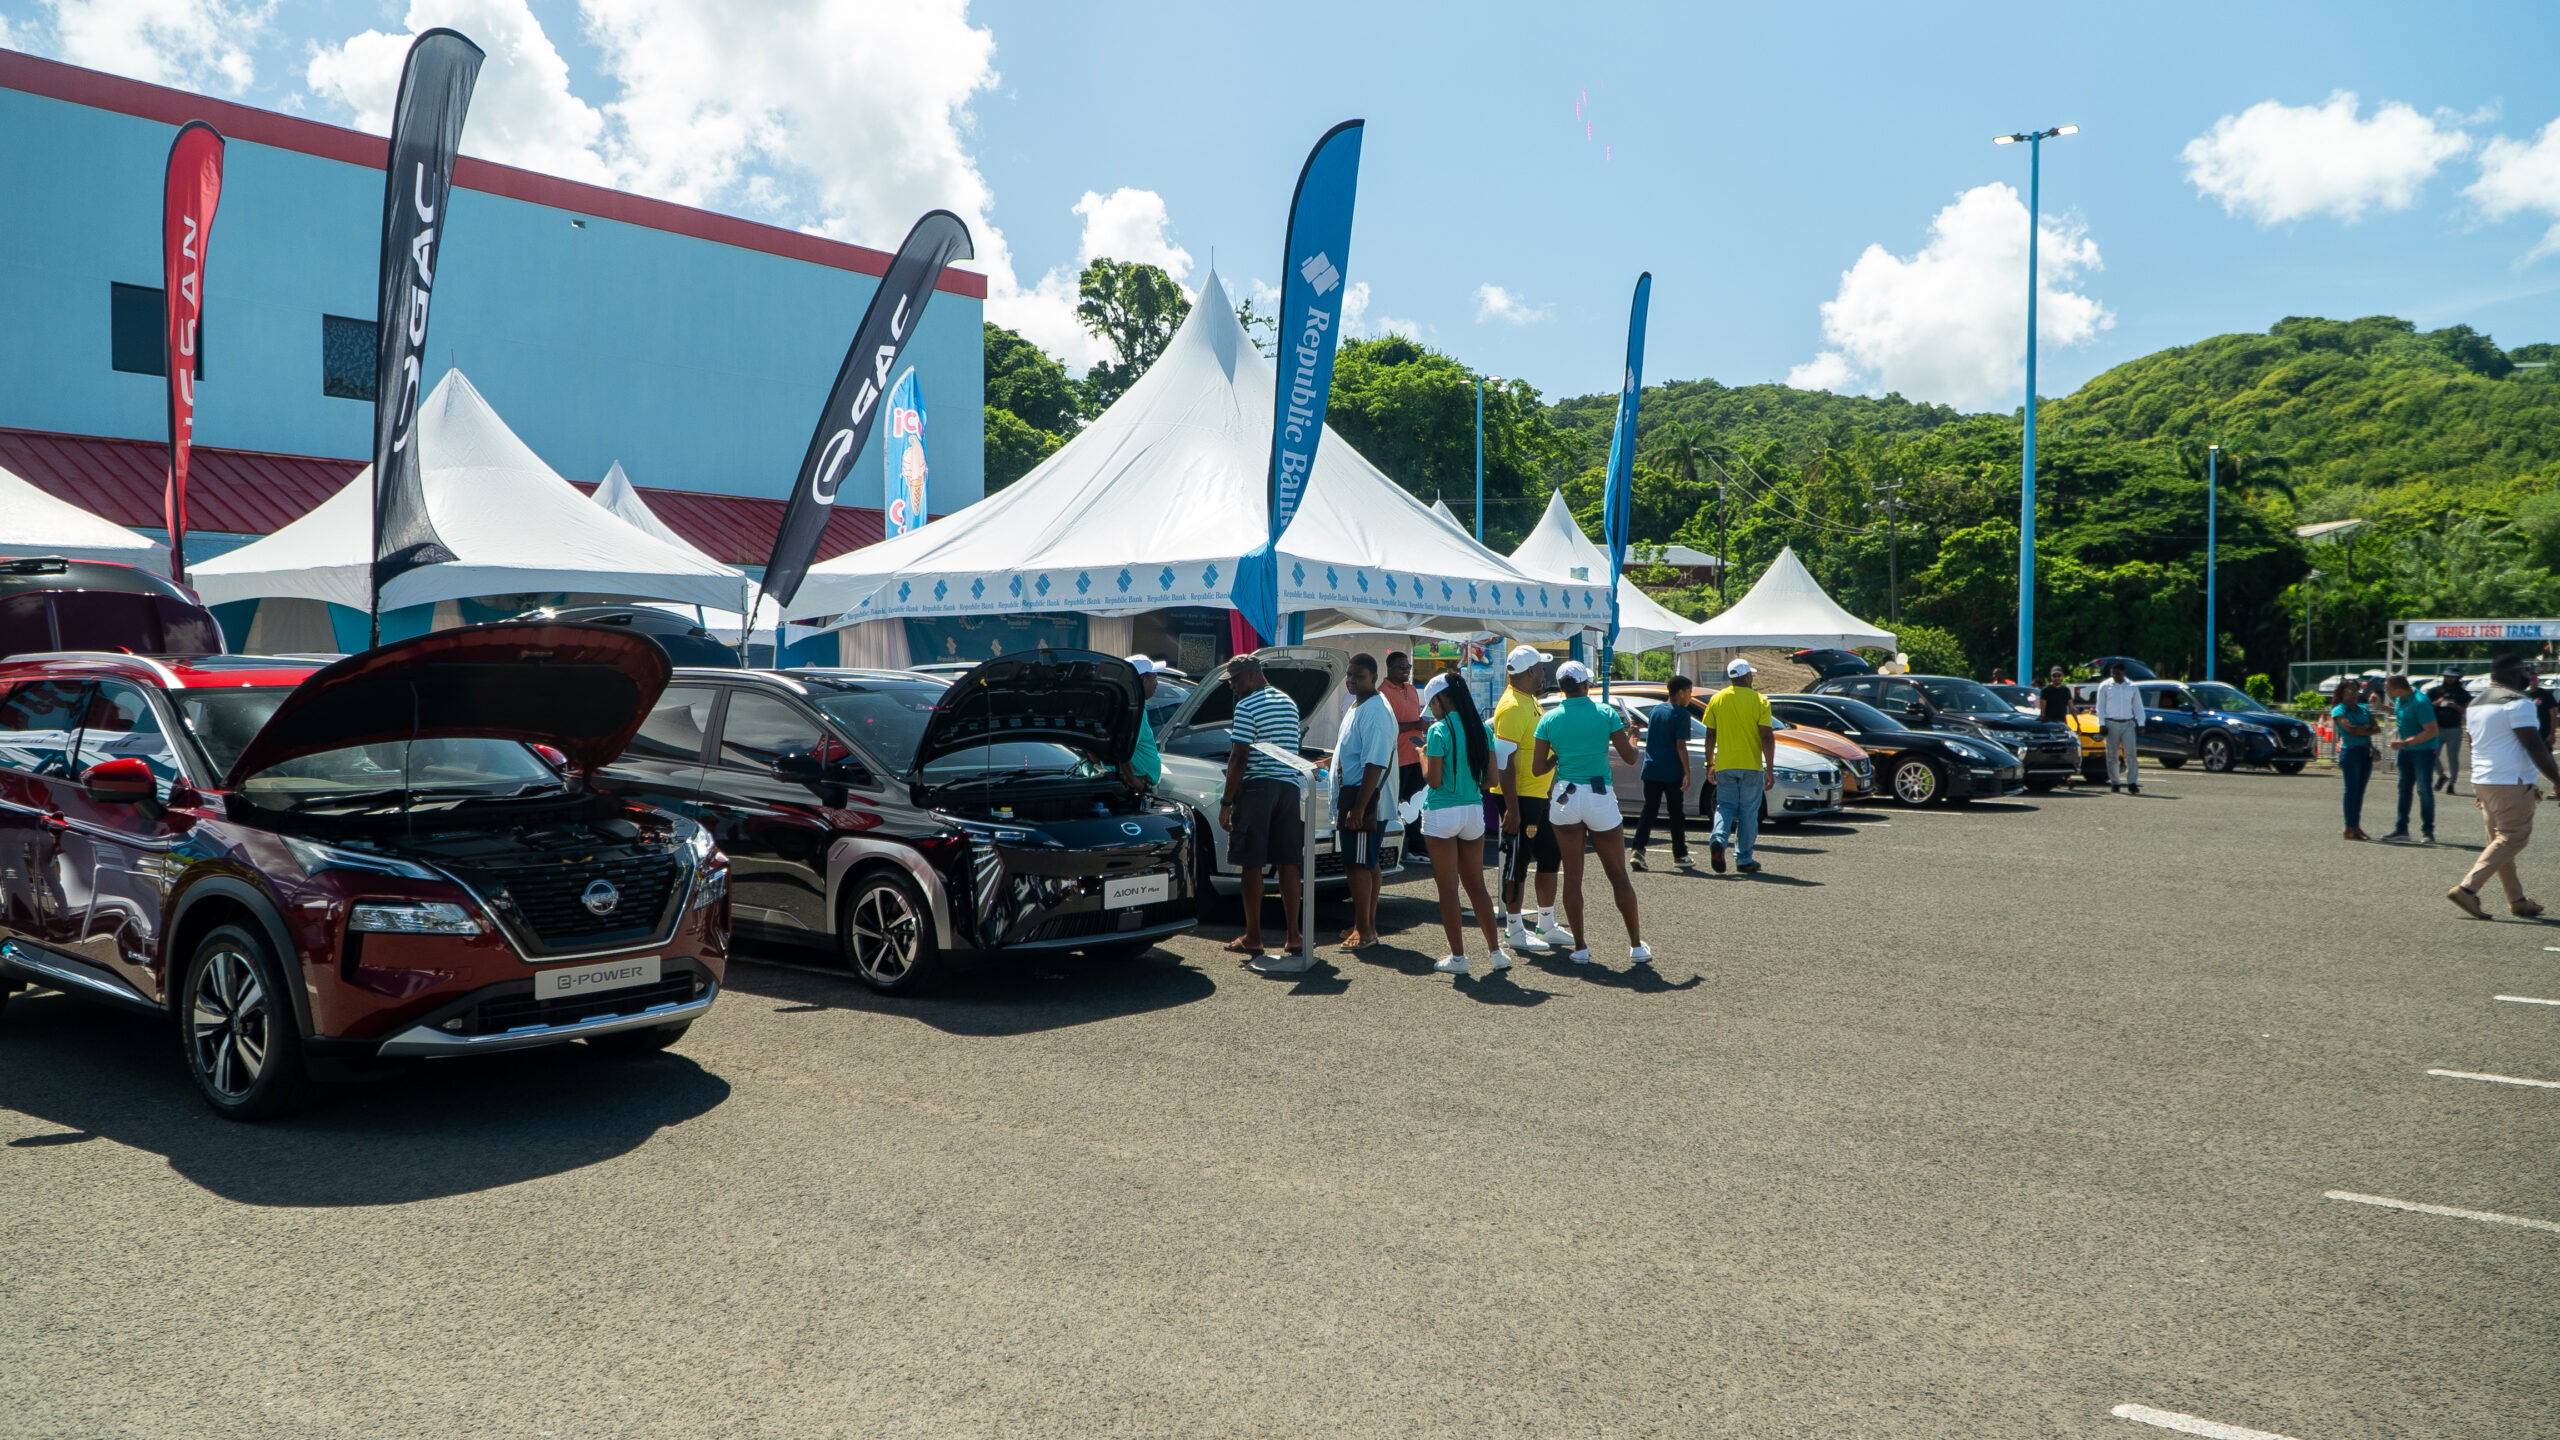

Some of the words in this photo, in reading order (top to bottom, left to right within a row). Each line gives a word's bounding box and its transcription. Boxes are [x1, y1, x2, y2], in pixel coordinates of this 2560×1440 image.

[409, 161, 436, 347] GAC
[851, 293, 911, 426] GAC
[1284, 305, 1331, 443] Republic
[1190, 592, 1214, 602] Republic
[2435, 625, 2476, 638] VEHICLE
[2479, 625, 2503, 638] TEST
[2506, 625, 2542, 638] TRACK
[1113, 887, 1139, 898] AION
[1141, 886, 1147, 894] Y
